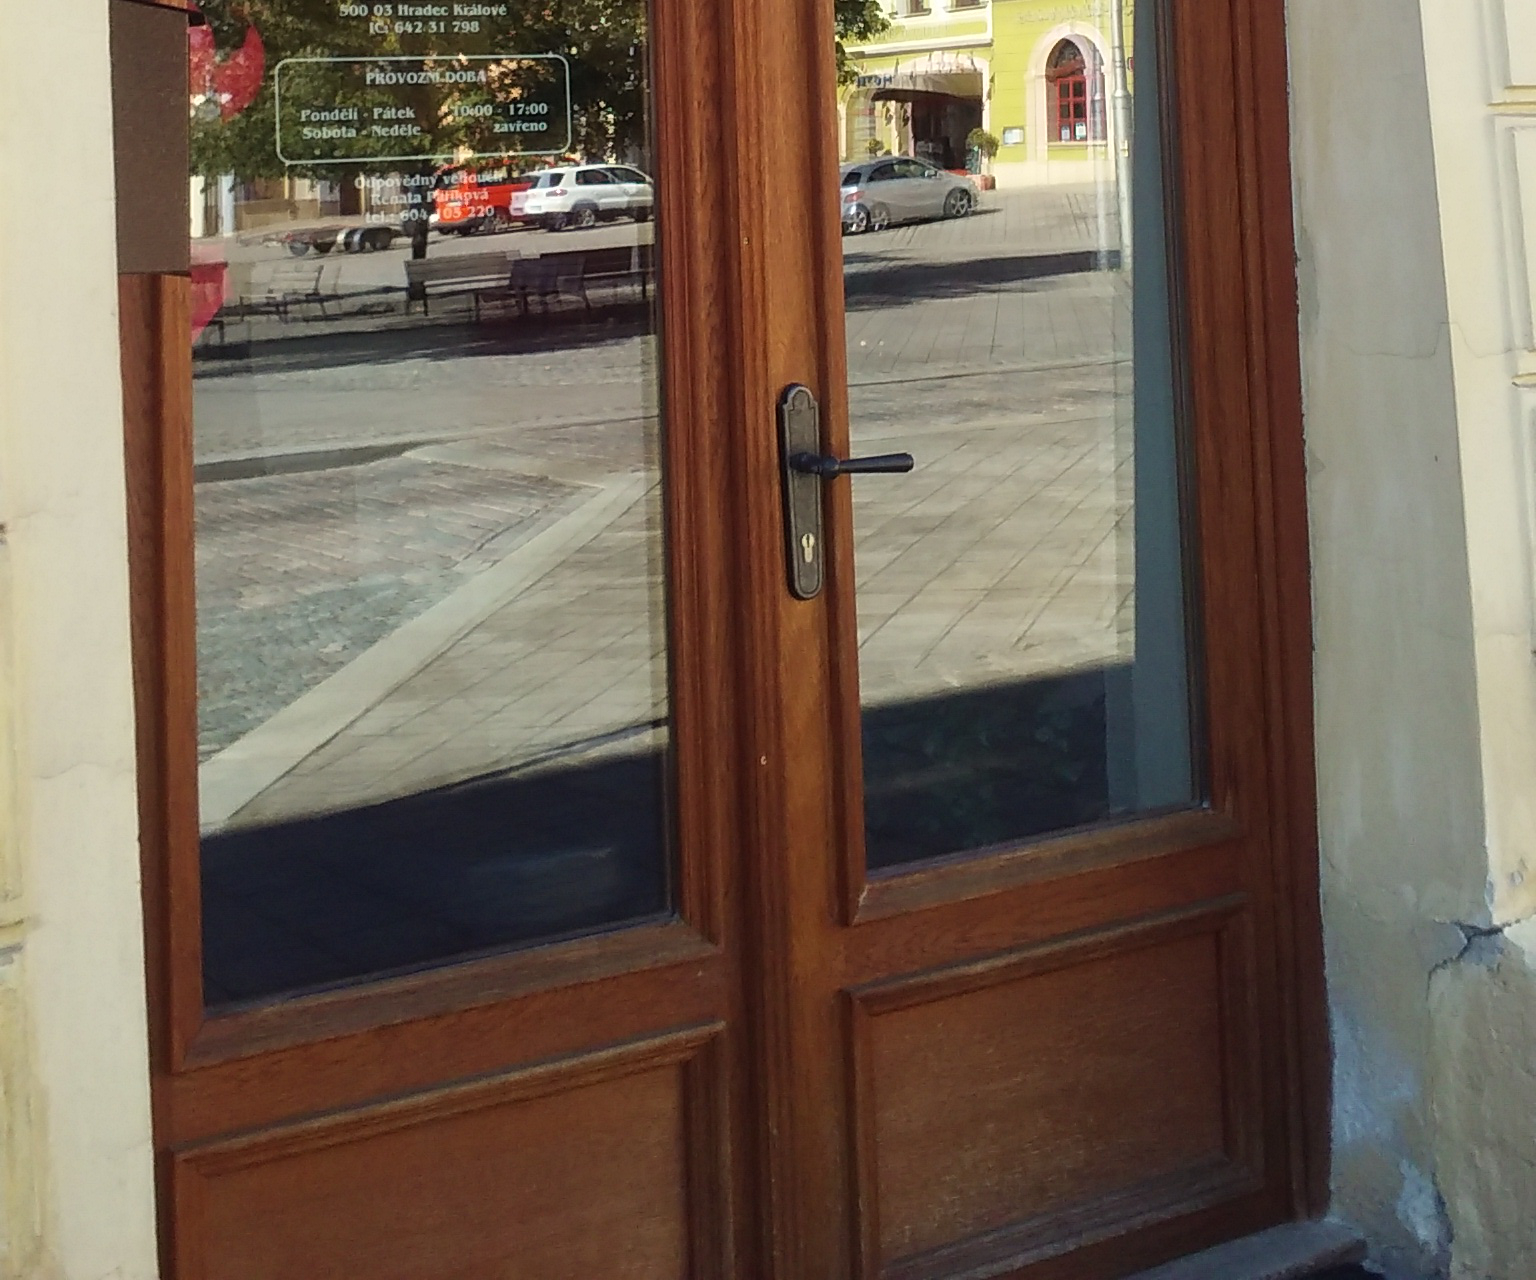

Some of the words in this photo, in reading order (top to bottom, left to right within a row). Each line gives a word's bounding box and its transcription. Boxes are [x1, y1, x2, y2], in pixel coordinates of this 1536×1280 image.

[339, 5, 368, 17] 500
[373, 4, 392, 17] 03
[398, 4, 449, 16] Hradec
[453, 4, 507, 16] Králové
[394, 21, 423, 34] 642
[428, 21, 445, 33] 31
[452, 21, 480, 33] 798
[446, 69, 487, 83] DOBA
[300, 107, 358, 121] Pondělí
[373, 107, 416, 120] Pátek
[453, 104, 493, 116] 10:00
[509, 103, 548, 116] 17:00
[302, 125, 357, 139] Sobota
[372, 124, 421, 137] Neděle
[493, 120, 548, 133] zavřeno
[354, 173, 438, 190] Odpovědný
[371, 192, 422, 206] Renata
[401, 208, 428, 221] 604
[469, 205, 495, 218] 220
